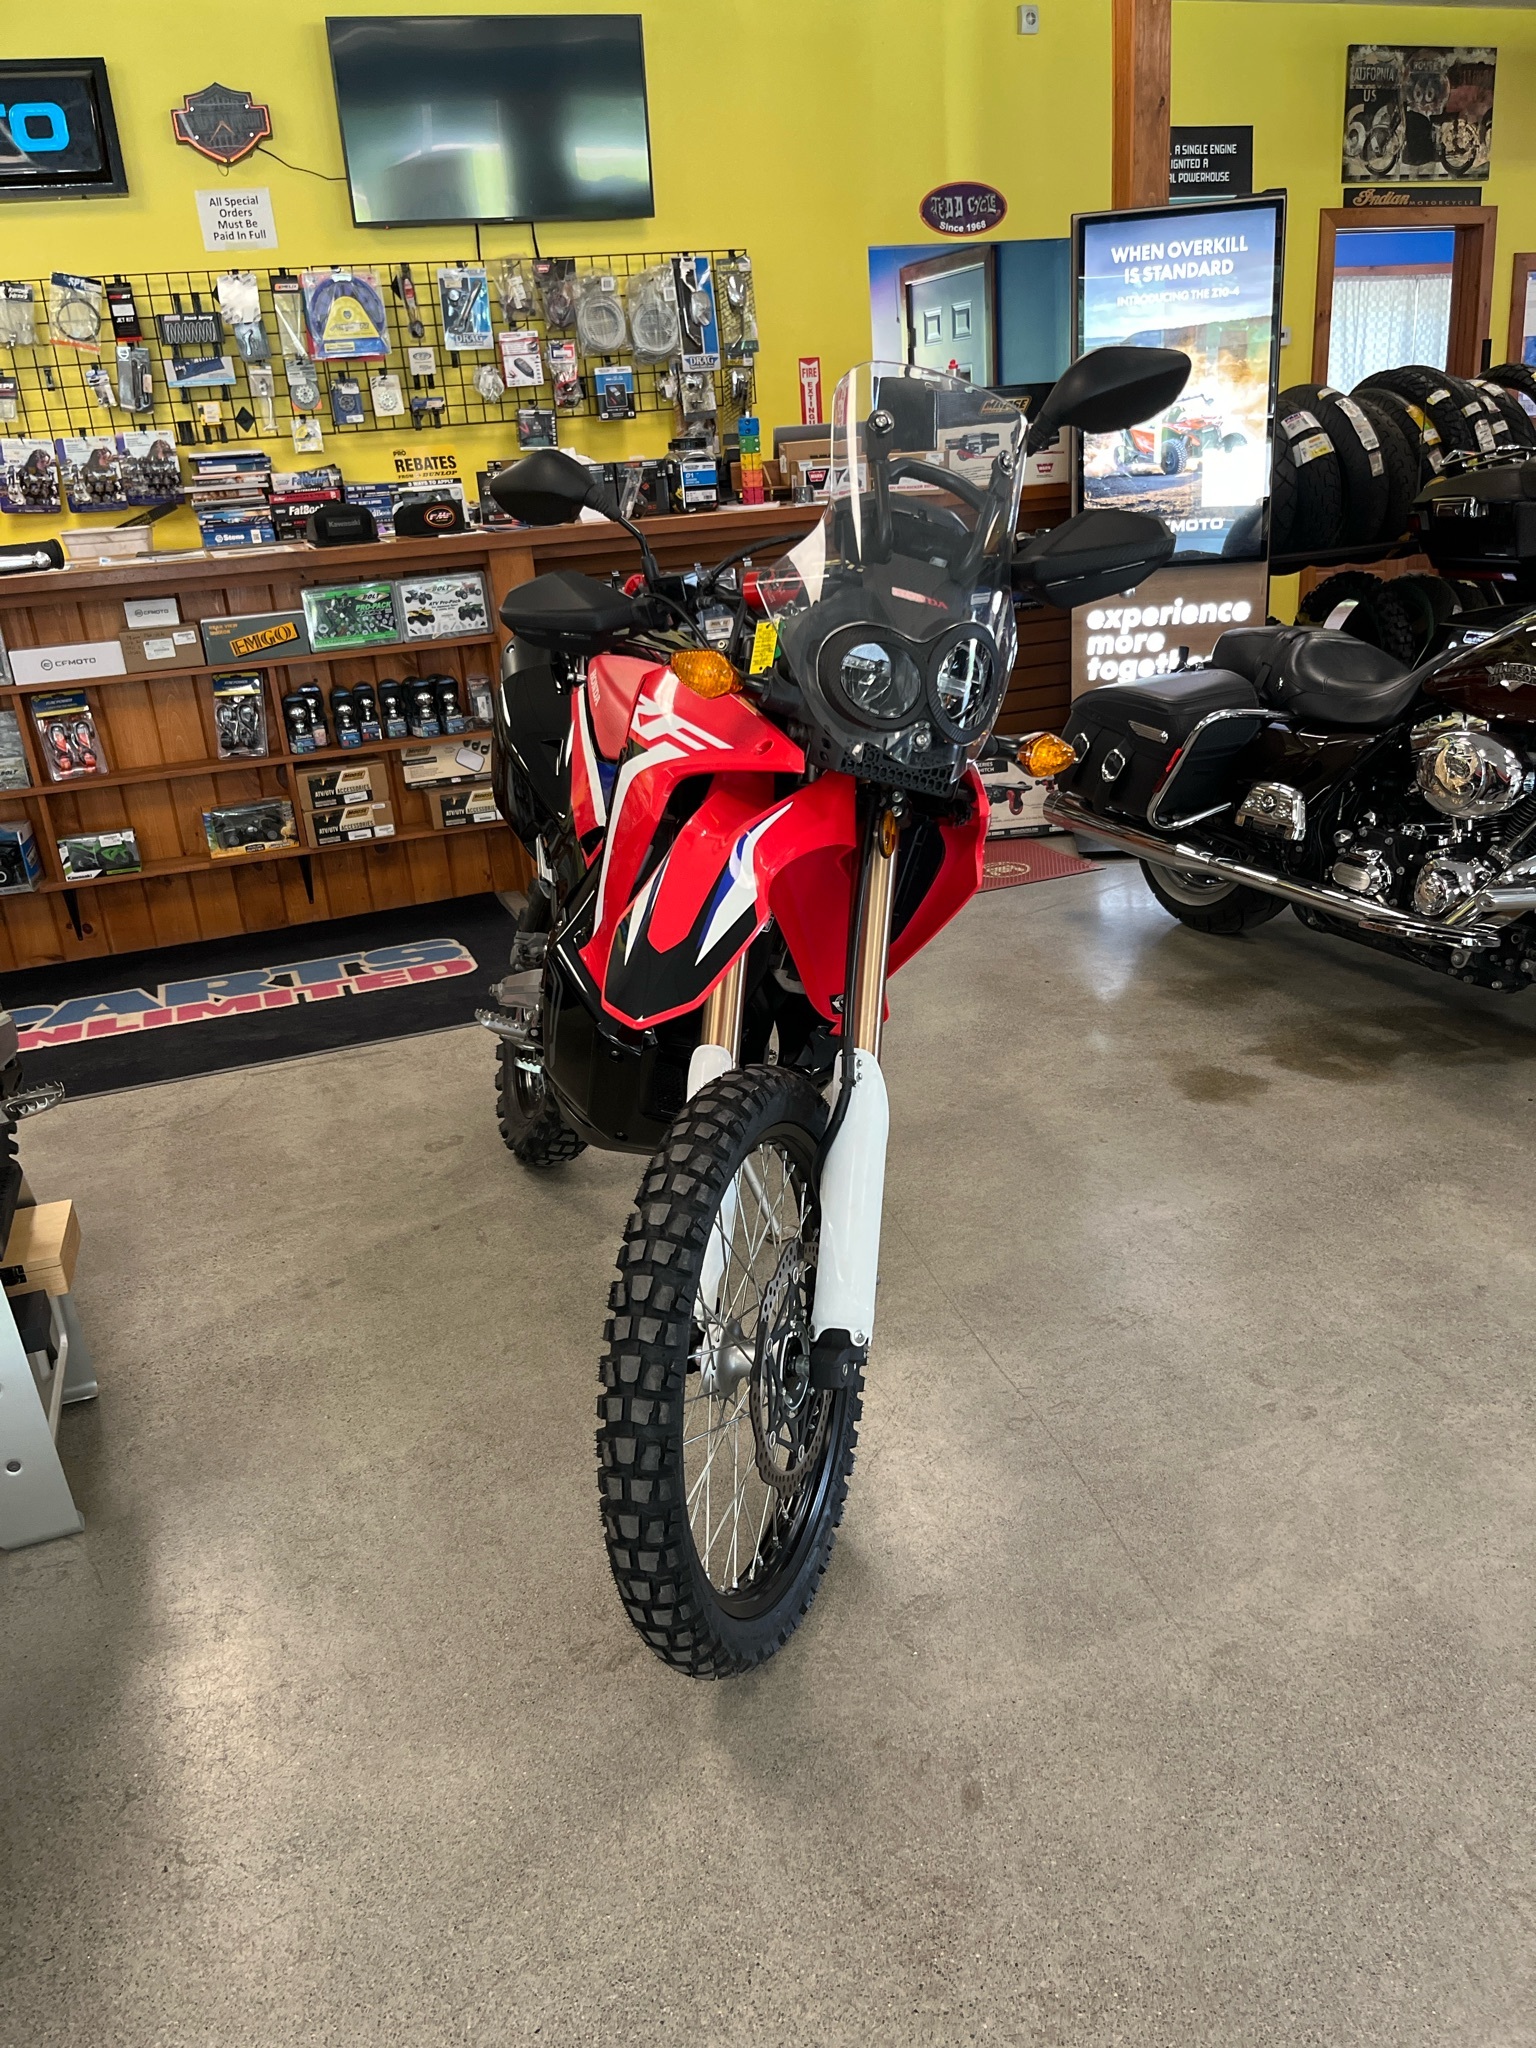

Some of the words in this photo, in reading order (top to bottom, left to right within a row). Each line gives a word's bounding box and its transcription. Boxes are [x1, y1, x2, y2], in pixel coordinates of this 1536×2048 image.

[1363, 89, 1377, 102] US
[0, 102, 70, 152] O
[1174, 145, 1181, 155] A
[1182, 144, 1208, 155] SINGLE
[1209, 143, 1237, 155] ENGINE
[1170, 158, 1201, 169] IGNITED
[1203, 158, 1209, 168] A
[1178, 171, 1230, 183] POWERHOUSE
[209, 197, 222, 207] All
[224, 195, 259, 208] Special
[1352, 188, 1411, 206] Indian
[967, 193, 997, 216] CYCLE
[219, 208, 253, 218] Orders
[217, 220, 243, 229] Must
[245, 219, 258, 228] Be
[939, 221, 964, 233] Since
[965, 219, 987, 232] 1968
[213, 231, 235, 241] Paid
[237, 231, 247, 240] In
[249, 229, 267, 239] Full
[1111, 243, 1165, 264] WHEN
[1167, 235, 1249, 259] OVERKILL
[1124, 266, 1140, 285] IS
[1142, 258, 1234, 284] STANDARD
[1116, 289, 1190, 308] INTRODUCING
[1191, 287, 1210, 300] THE
[455, 333, 484, 343] DRAG
[689, 356, 715, 366] DRAG
[801, 367, 818, 378] FIRE
[394, 455, 457, 473] REBATES
[422, 470, 458, 478] DUNLOP
[288, 503, 324, 517] FatBo
[429, 511, 452, 521] FMF
[328, 519, 361, 528] Kawasaki
[1167, 517, 1225, 534] MOTO
[143, 608, 169, 616] CFMOTO
[355, 601, 392, 612] PRO-PACK
[1086, 597, 1251, 634] experience
[231, 625, 292, 656] EMGO
[1086, 631, 1165, 656] more
[54, 657, 97, 667] CFMOTO
[590, 667, 601, 708] HONDA
[315, 789, 335, 798] ATV/UTV
[337, 784, 370, 794] ACCESSORIES
[319, 826, 339, 835] ATV/UTV
[341, 820, 374, 831] ACCESSORIES
